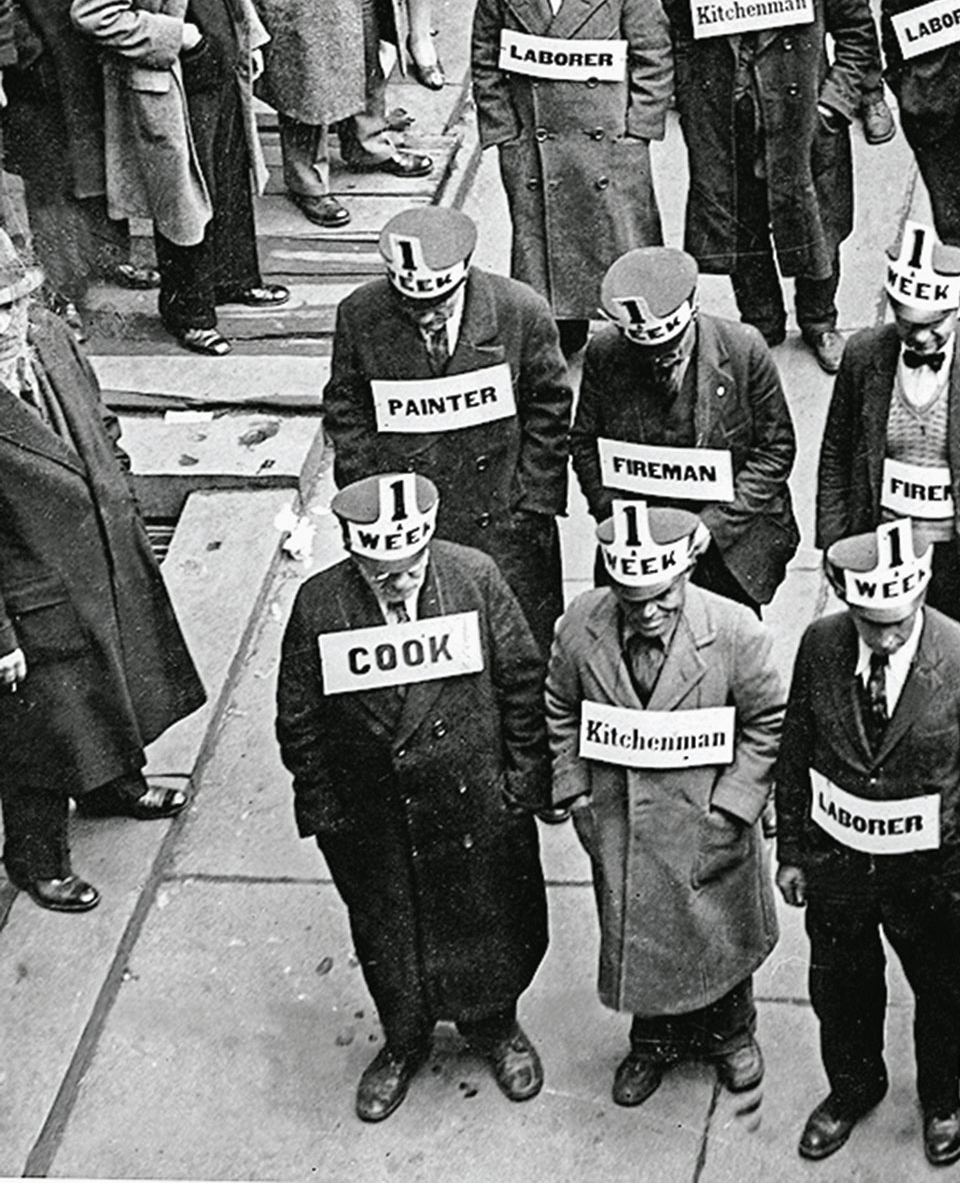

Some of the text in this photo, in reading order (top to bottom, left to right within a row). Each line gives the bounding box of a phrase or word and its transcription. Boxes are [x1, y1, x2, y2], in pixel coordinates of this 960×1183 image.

[509, 45, 614, 67] LABORER
[398, 240, 418, 272] 1
[907, 229, 925, 270] 1
[887, 267, 950, 301] WEEK
[621, 299, 647, 324] 1
[388, 386, 498, 416] PAINTER
[613, 457, 717, 482] FIREMAN
[390, 480, 408, 522] 1
[623, 505, 643, 547] 1
[886, 527, 904, 569] 1
[347, 633, 453, 675] COOK
[586, 720, 727, 751] Kitchenman
[819, 792, 924, 836] LABORER
